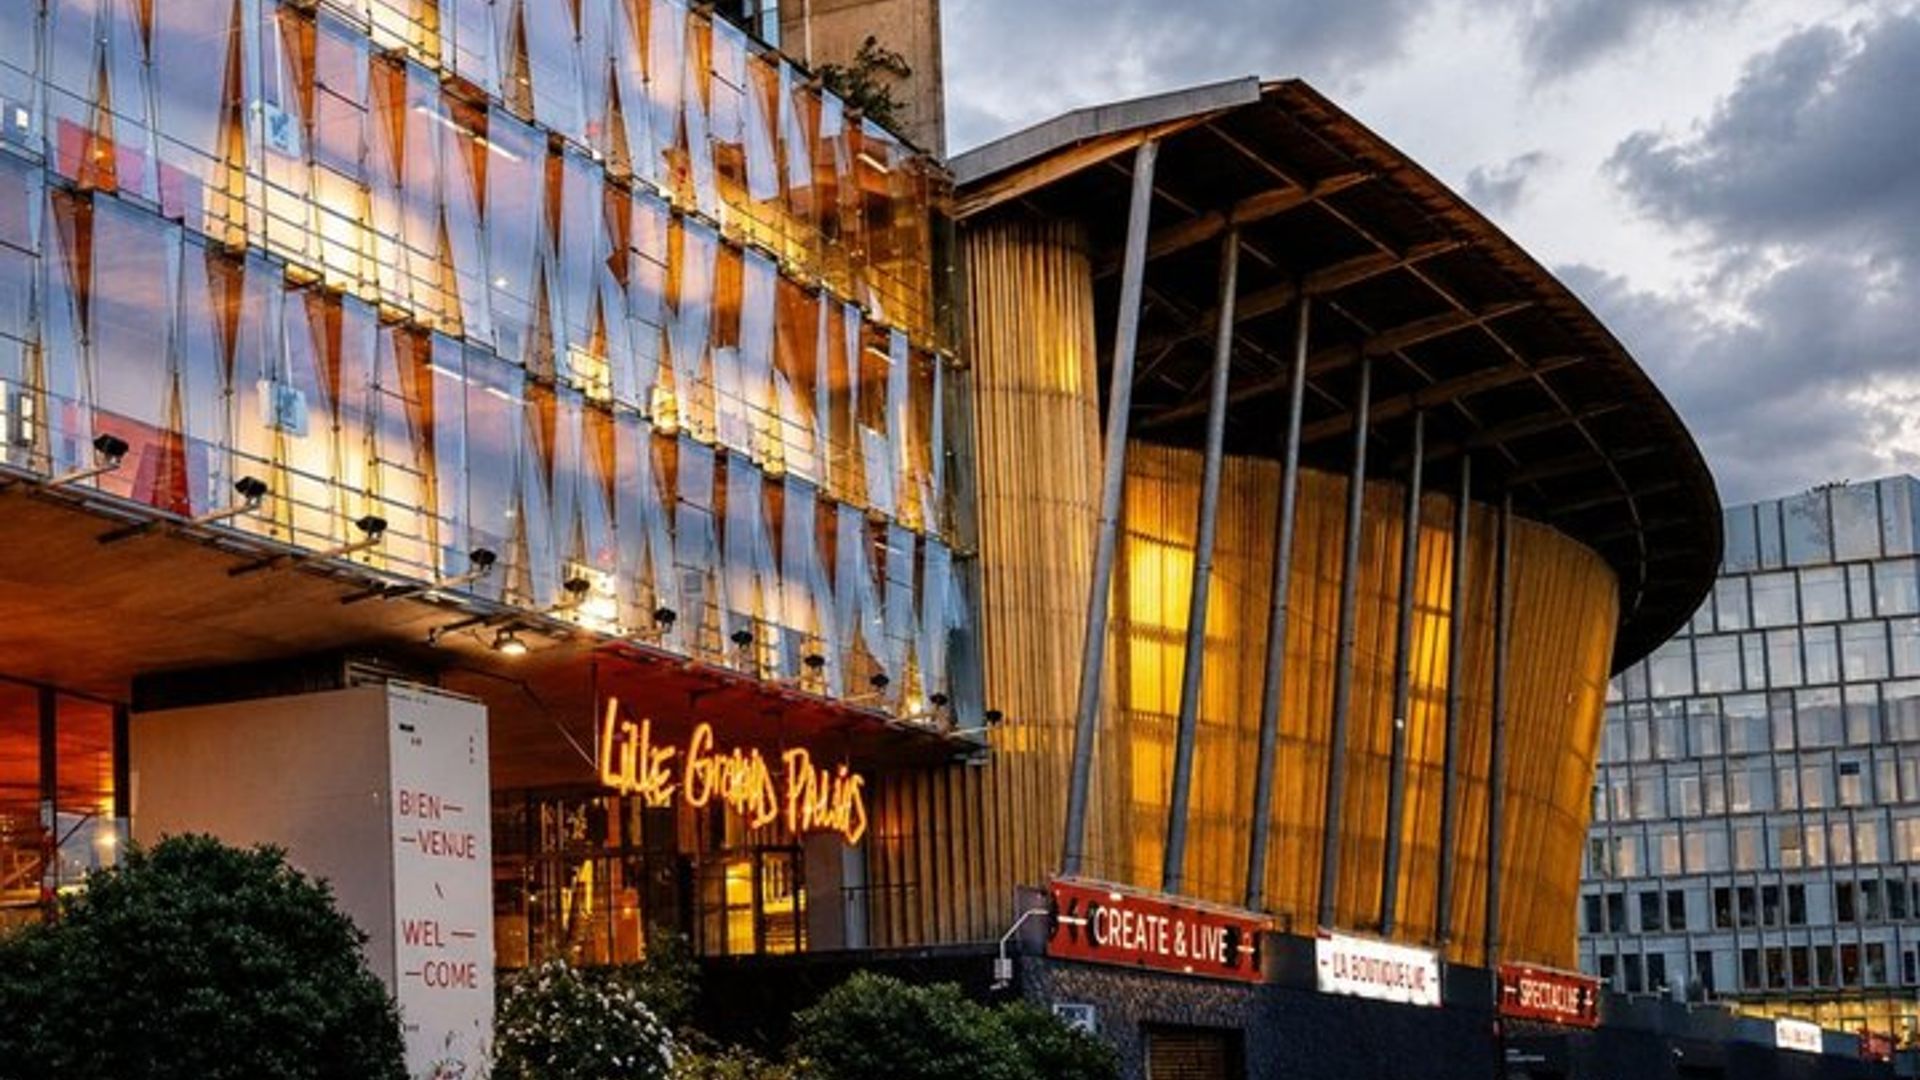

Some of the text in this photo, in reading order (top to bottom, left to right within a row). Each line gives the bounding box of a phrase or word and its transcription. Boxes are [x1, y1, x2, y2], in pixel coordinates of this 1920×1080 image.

[1093, 905, 1229, 964] CREATE & LIVE
